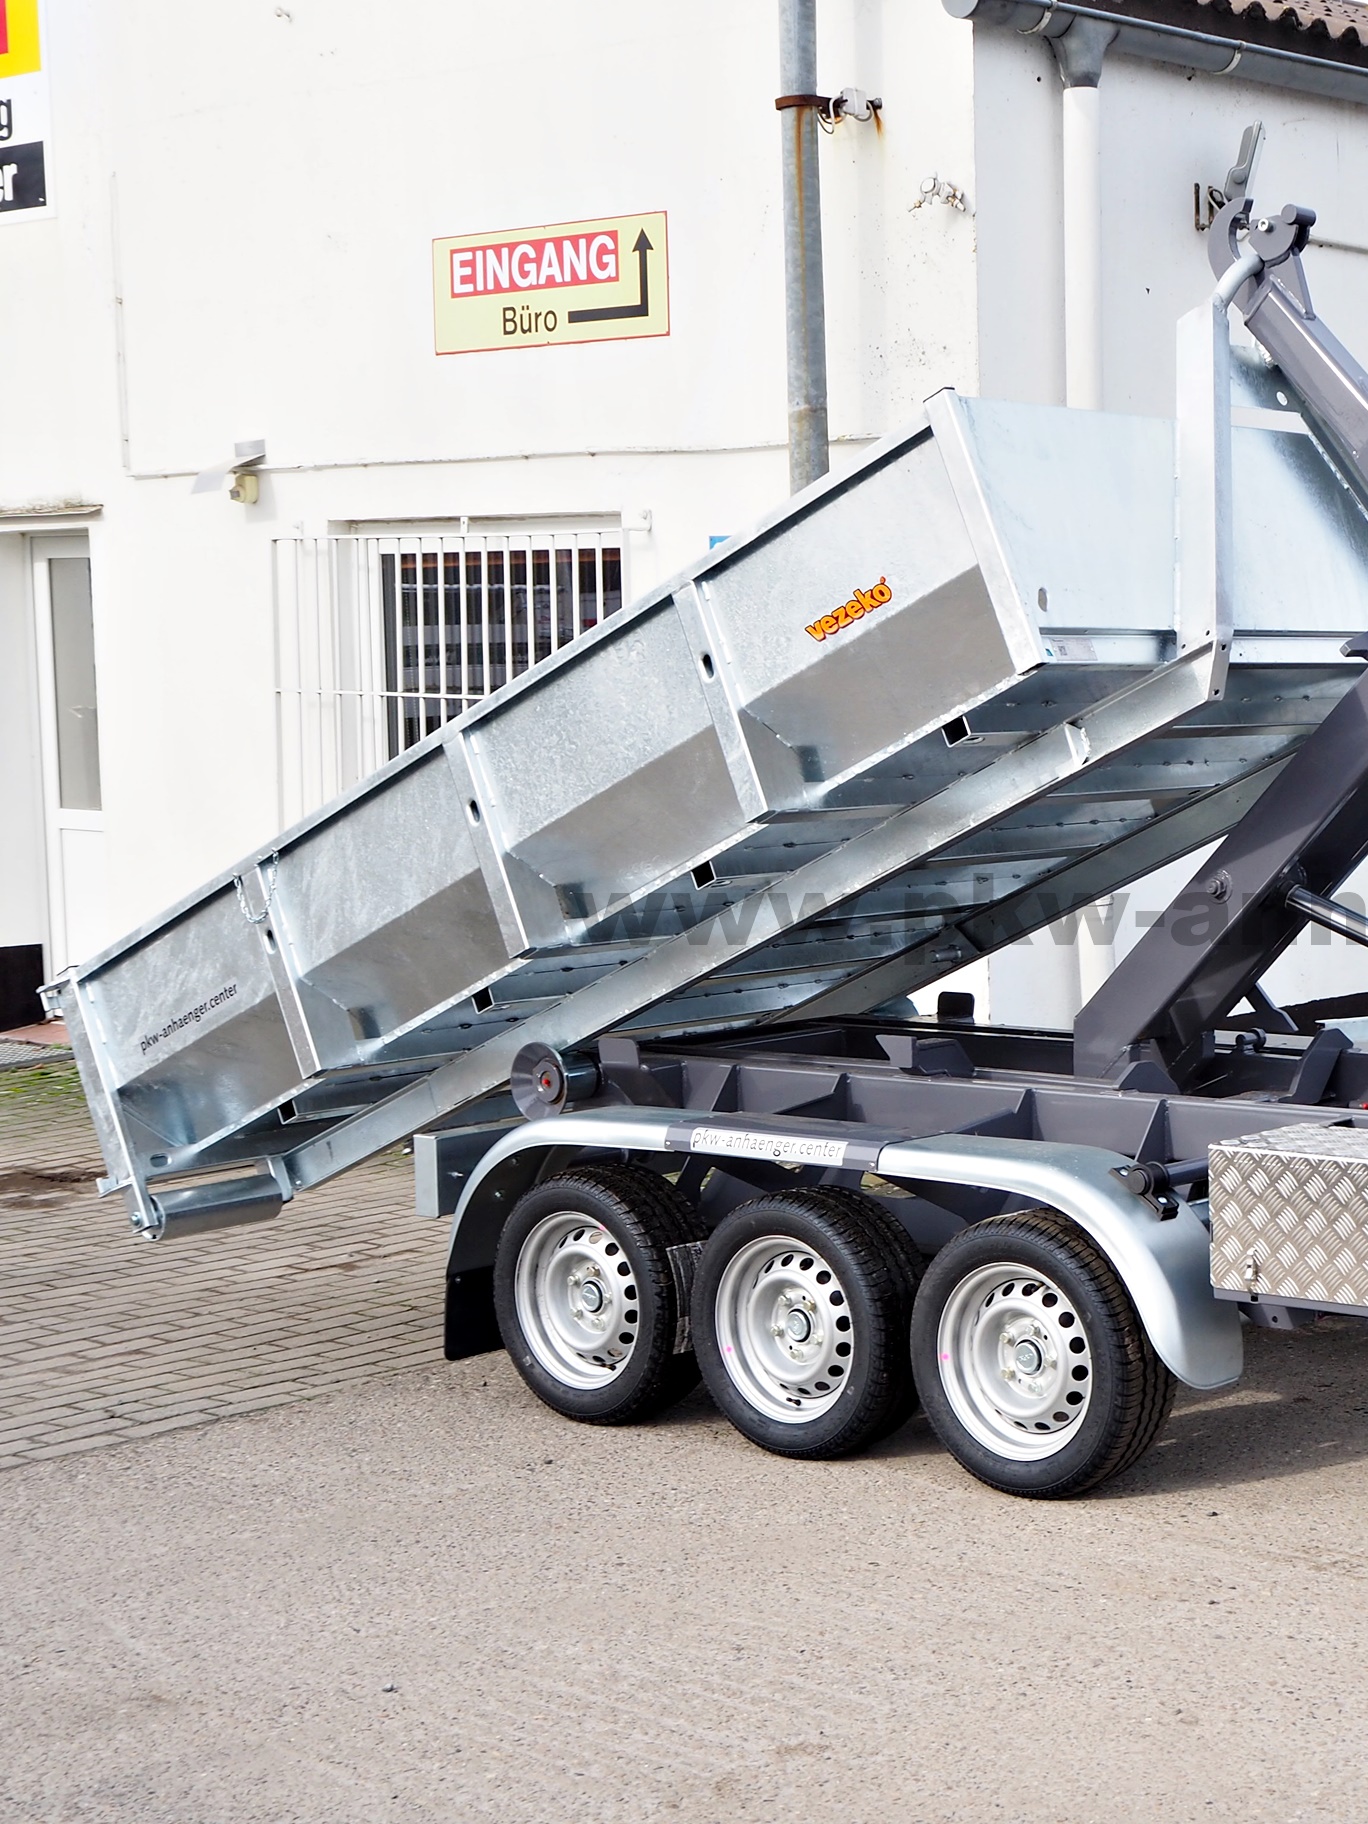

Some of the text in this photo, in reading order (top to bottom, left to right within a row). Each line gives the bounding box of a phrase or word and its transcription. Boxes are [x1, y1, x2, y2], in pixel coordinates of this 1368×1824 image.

[452, 234, 617, 294] EINGANG
[502, 304, 558, 336] Büro
[804, 576, 893, 643] vezeko
[140, 983, 238, 1056] pkw-anhaenger.center
[692, 1128, 842, 1158] pkw-anhaenger.center
